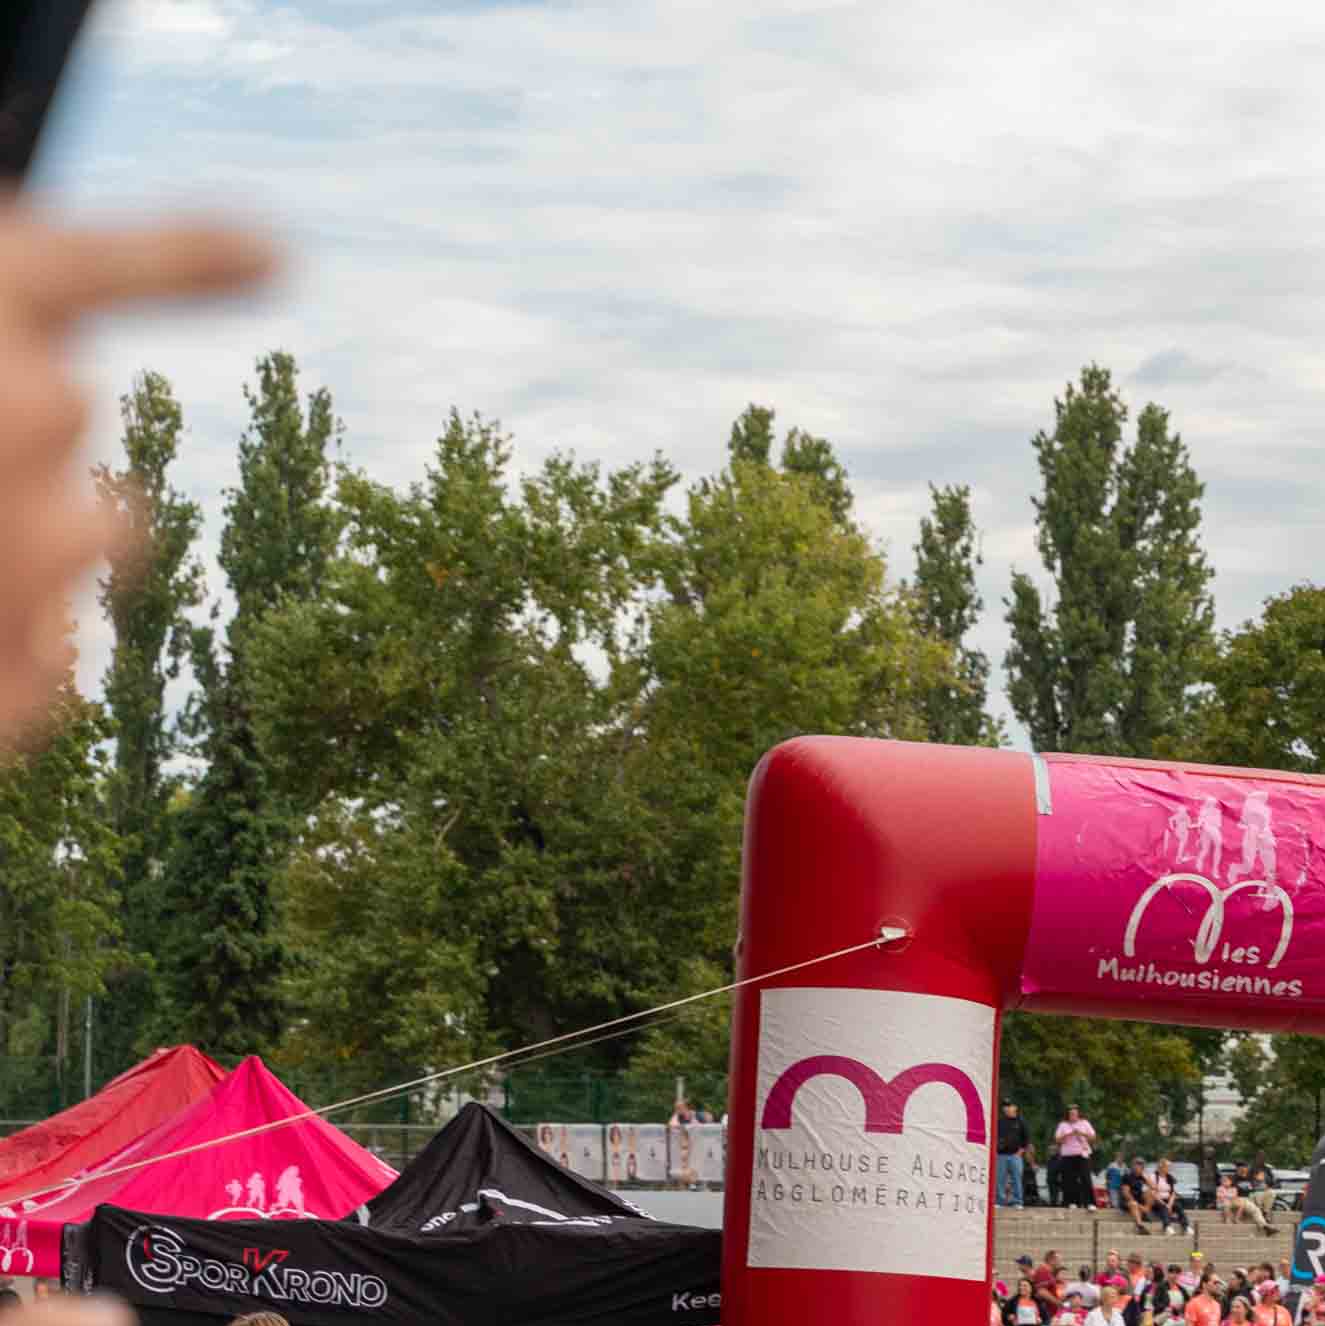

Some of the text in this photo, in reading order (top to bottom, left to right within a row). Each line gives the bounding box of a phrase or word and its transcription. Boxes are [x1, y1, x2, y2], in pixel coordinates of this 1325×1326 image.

[1221, 942, 1261, 964] les
[1096, 957, 1303, 997] Mulhousiennes
[757, 1148, 987, 1184] MULHOUSE ALSACE
